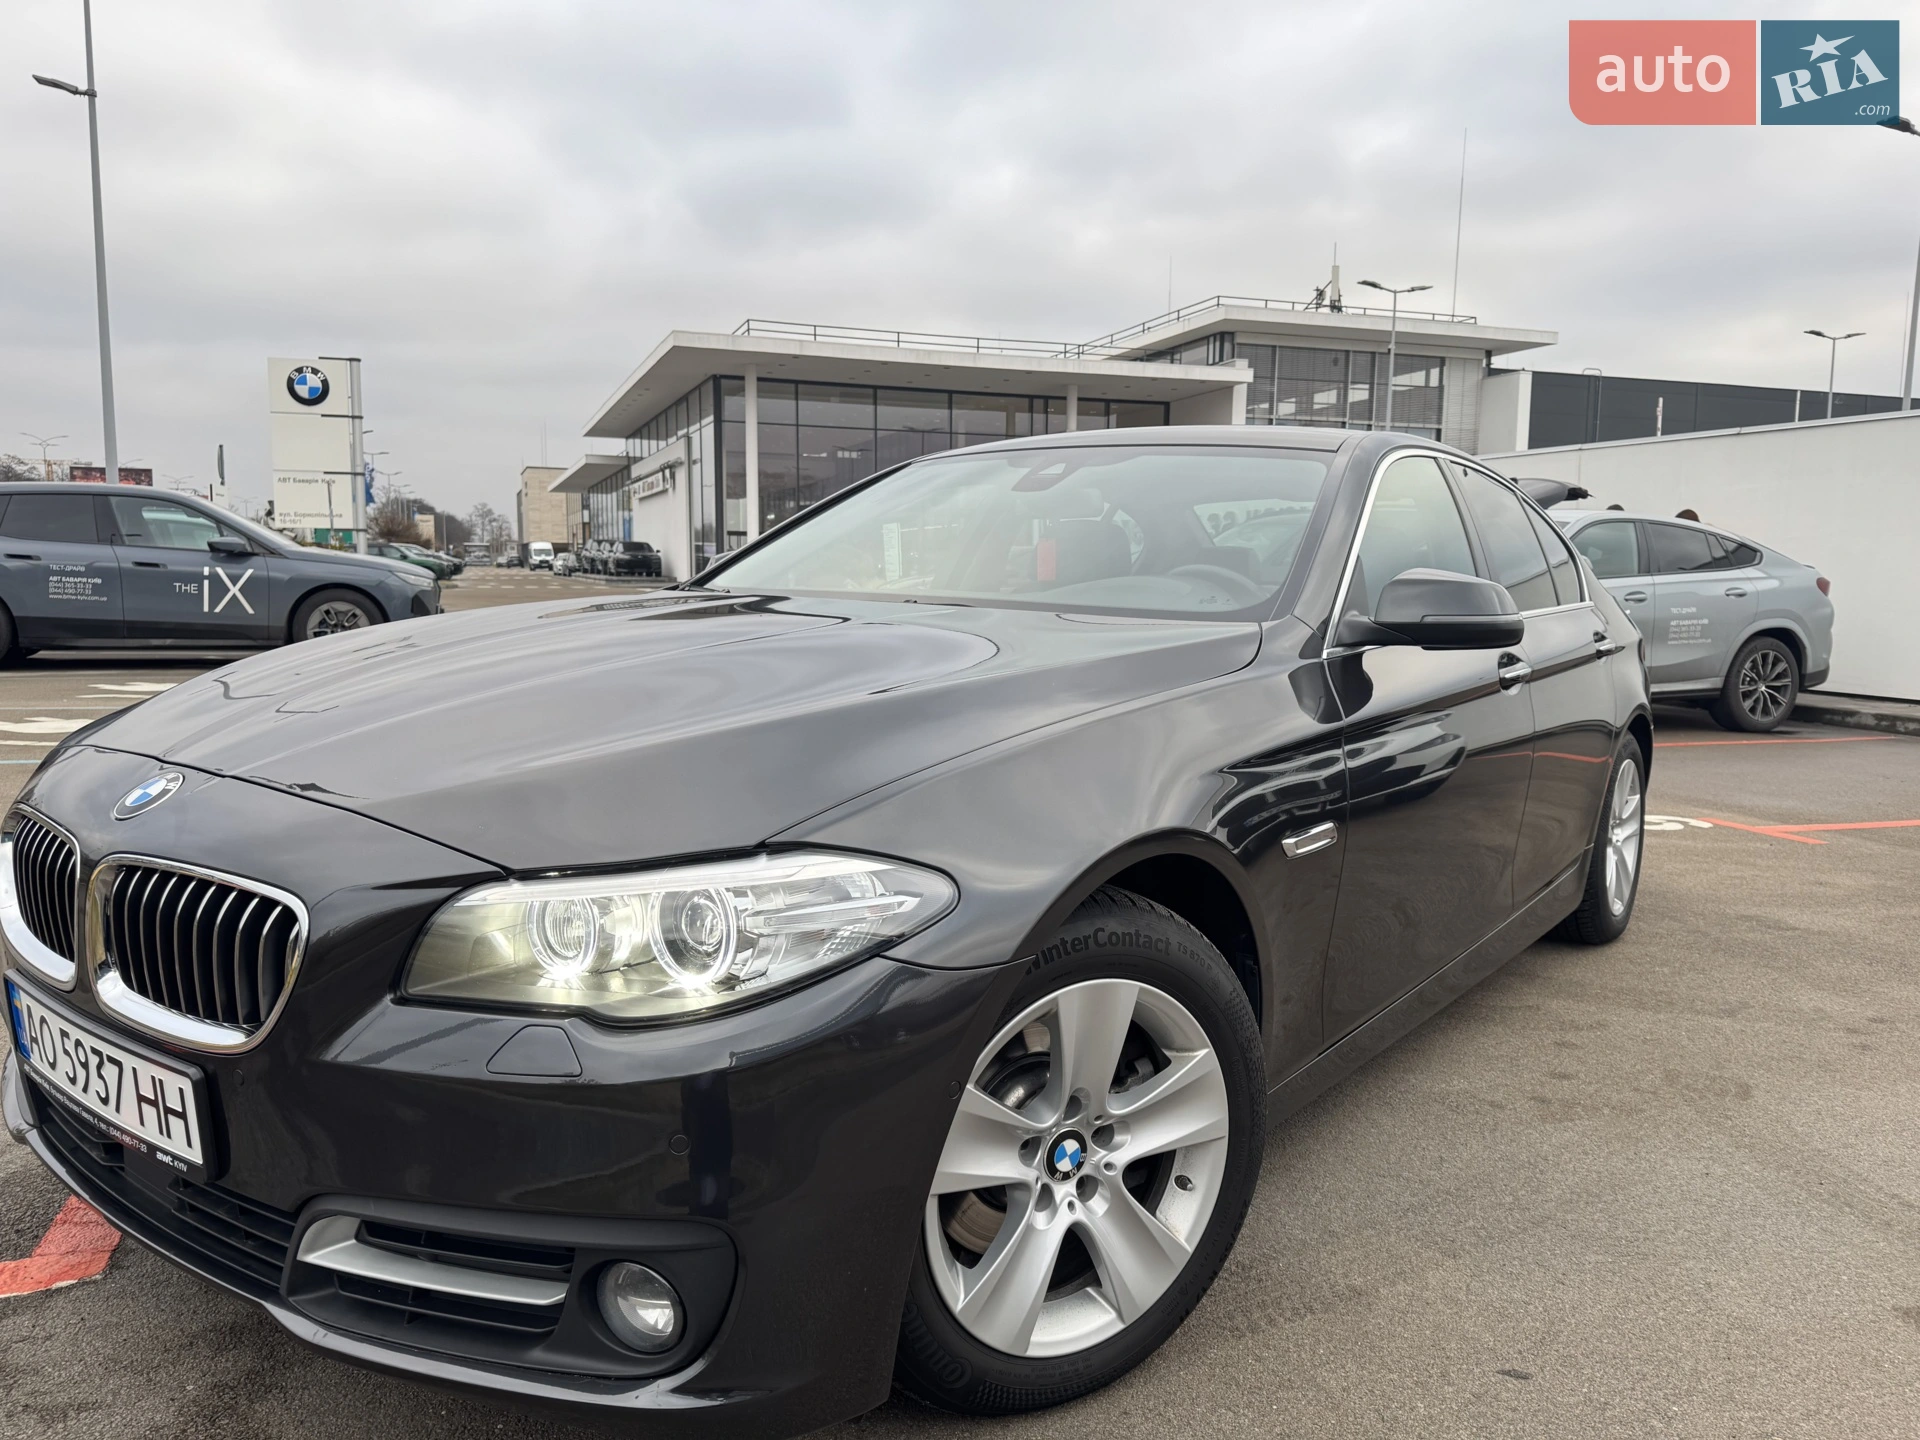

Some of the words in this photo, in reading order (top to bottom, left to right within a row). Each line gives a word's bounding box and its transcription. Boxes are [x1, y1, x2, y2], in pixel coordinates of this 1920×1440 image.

[290, 366, 326, 381] BMW
[49, 564, 86, 572] ТЕСТ-ДРАЙВ
[173, 583, 198, 594] THE
[203, 566, 255, 614] iX
[1177, 941, 1188, 955] TS
[59, 1027, 124, 1114] 5937
[132, 1066, 194, 1149] HH
[156, 1151, 174, 1166] awt
[174, 1160, 188, 1172] KYIV
